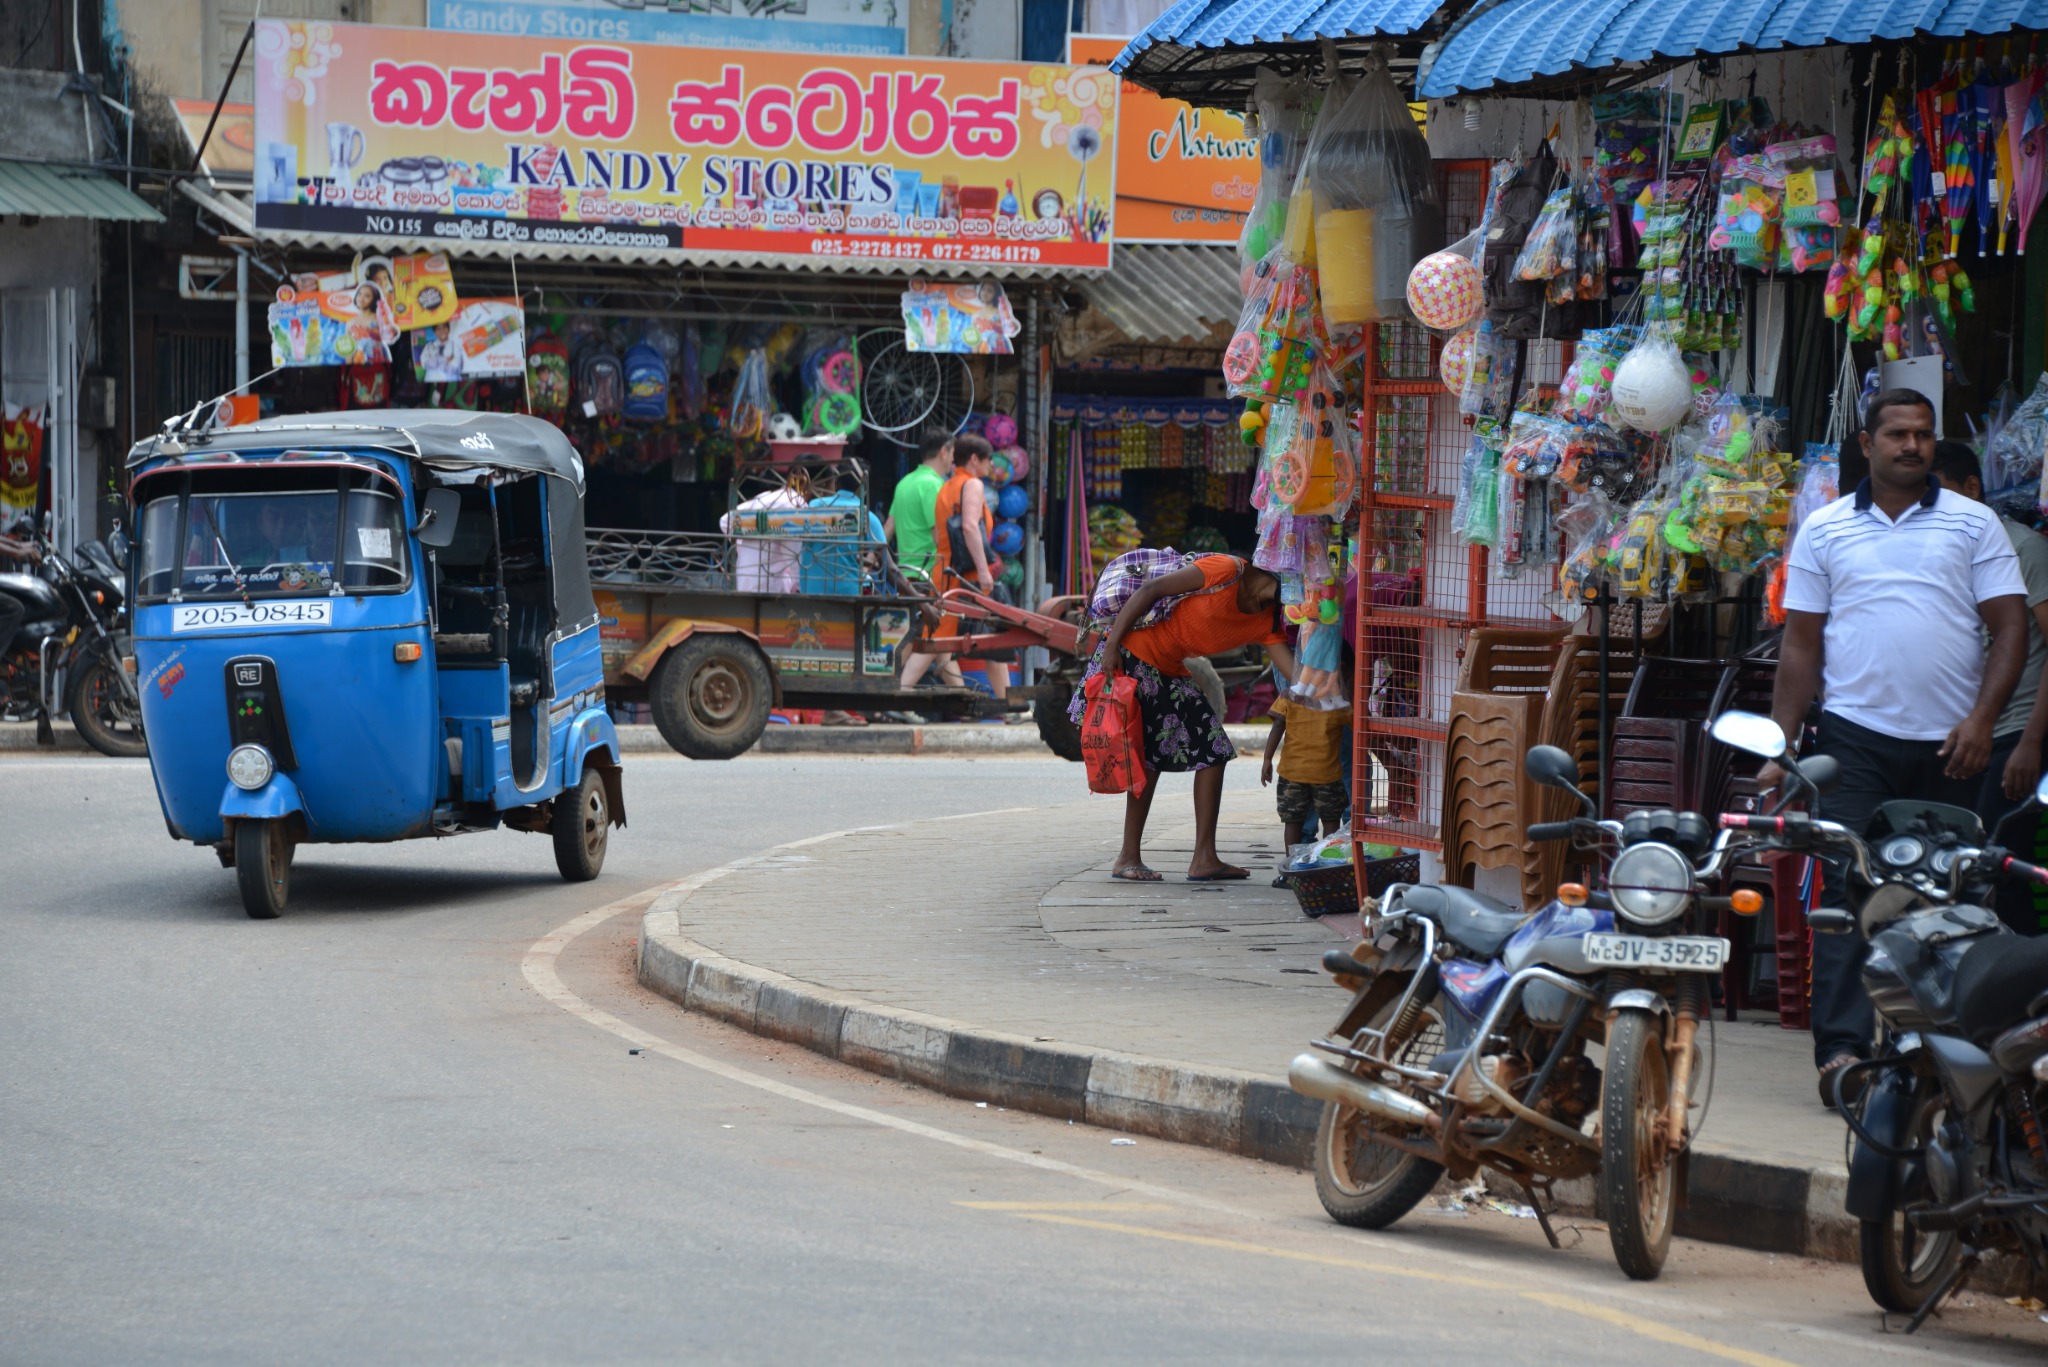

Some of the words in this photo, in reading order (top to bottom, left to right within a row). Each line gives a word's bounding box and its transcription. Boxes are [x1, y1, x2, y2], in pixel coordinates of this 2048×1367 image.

[444, 7, 531, 35] Kandy
[540, 10, 630, 40] Stores
[509, 145, 689, 194] KANDY
[703, 156, 894, 204] STORES
[366, 215, 394, 233] NO
[398, 218, 422, 235] 155
[932, 243, 1041, 263] 077-2264179
[184, 603, 325, 627] 205-0845
[240, 670, 257, 682] RE
[1590, 947, 1612, 961] NC
[1614, 940, 1719, 966] JV-3525
